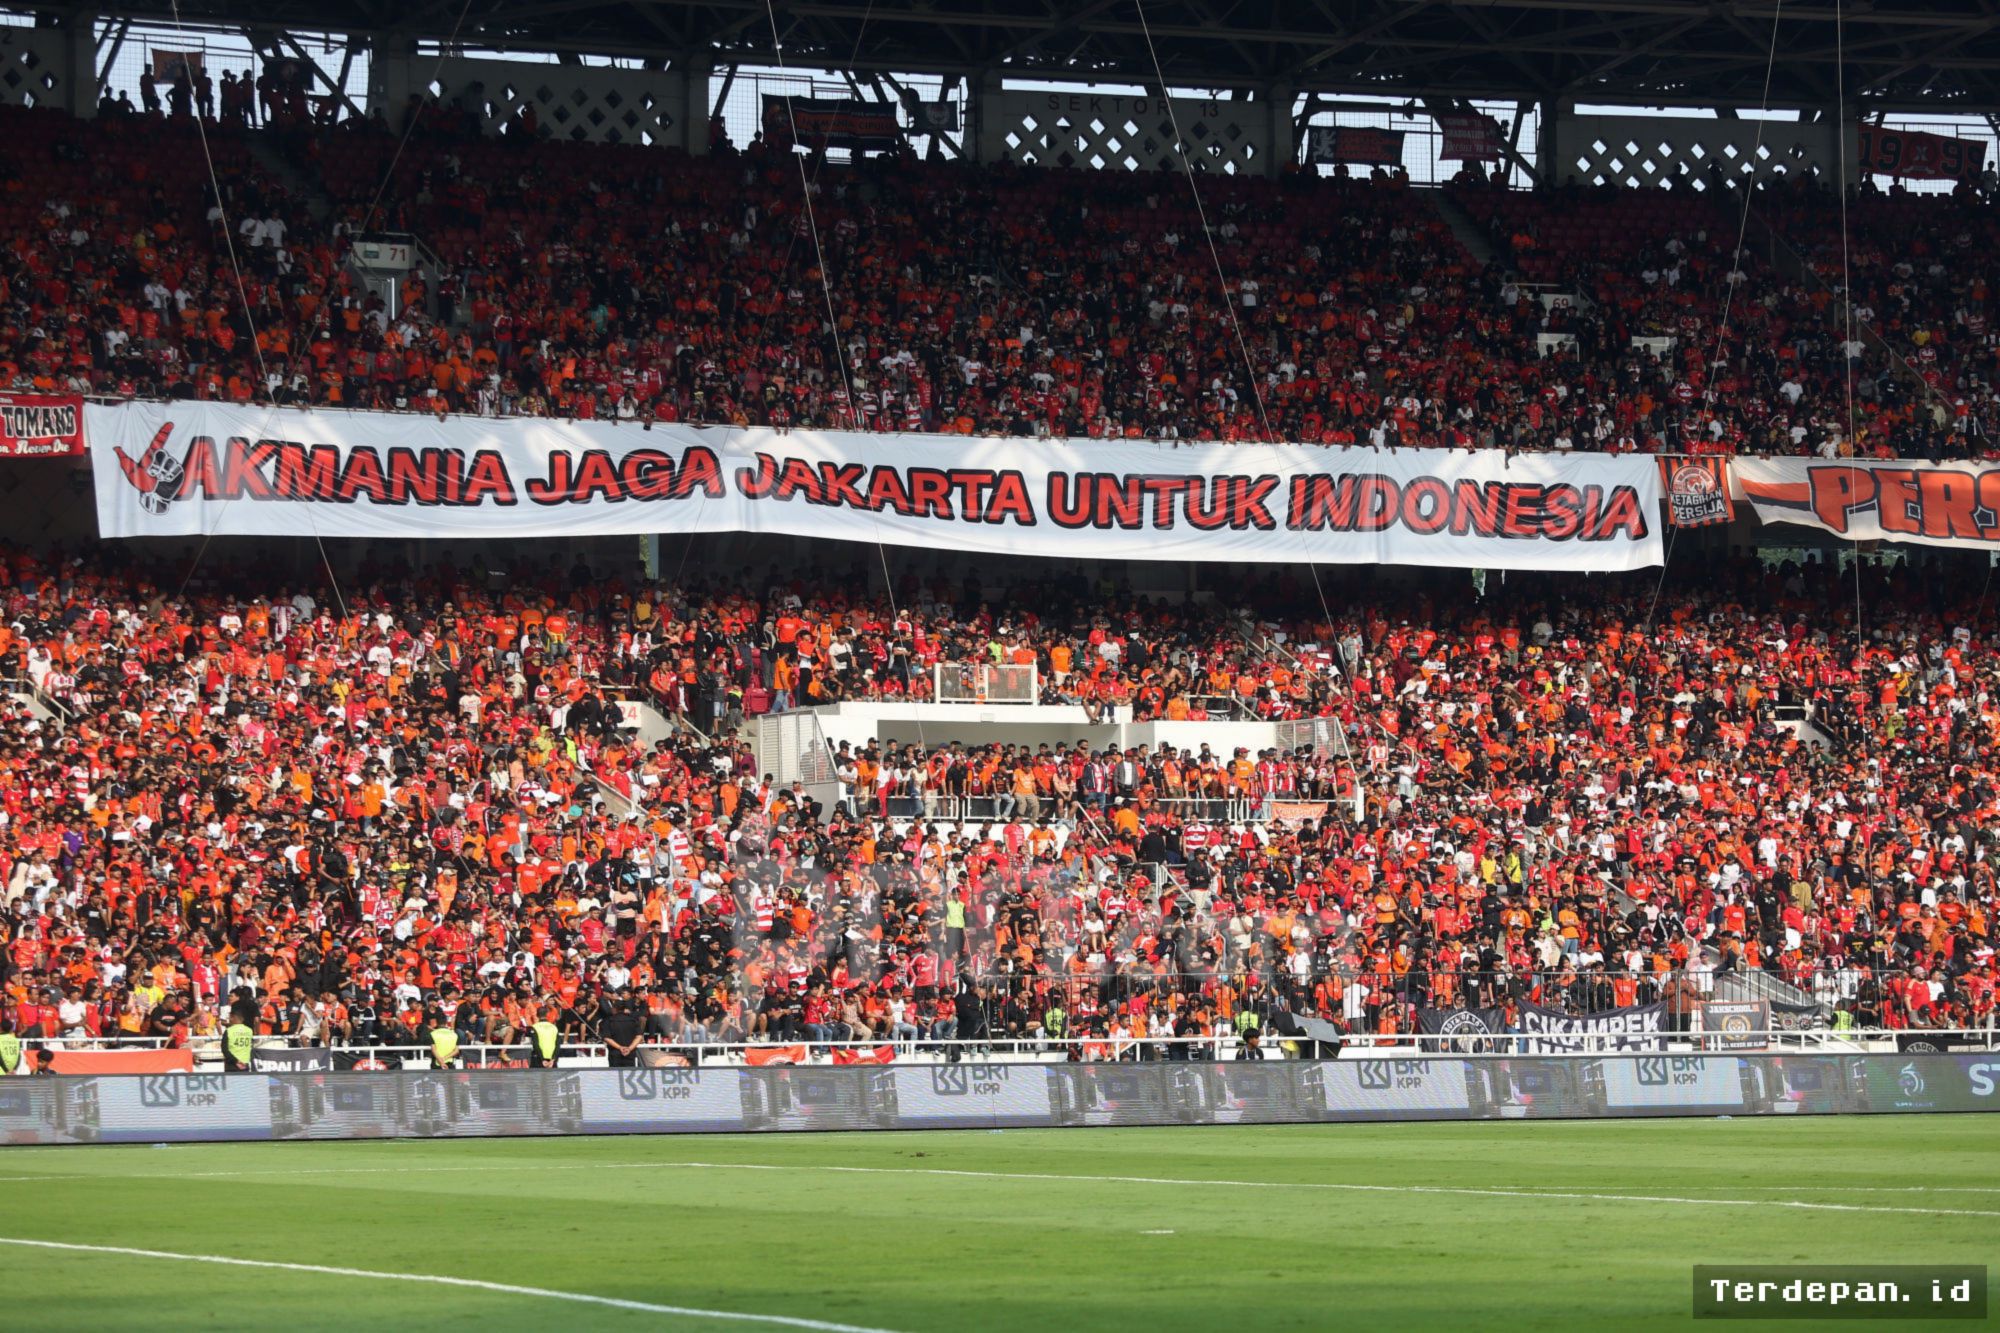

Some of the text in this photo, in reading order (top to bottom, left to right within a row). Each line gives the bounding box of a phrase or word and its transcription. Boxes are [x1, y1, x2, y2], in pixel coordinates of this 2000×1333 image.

[1047, 94, 1219, 118] SEKTOR 13
[390, 247, 406, 262] 71
[523, 445, 727, 506] JAGA
[735, 451, 1037, 527] JAKARTA
[1046, 472, 1283, 531] UNTUK
[1287, 473, 1649, 542] INDONESIA
[1673, 498, 1725, 520] PERSIJA
[1524, 1010, 1662, 1046] CIKAMPEK
[233, 1037, 250, 1048] 450
[1394, 1060, 1431, 1075] BRI
[1671, 1057, 1706, 1071] BRI
[661, 1069, 700, 1084] BRI
[972, 1066, 1009, 1080] BRI
[1674, 1073, 1698, 1085] KPR
[185, 1075, 227, 1091] BRI
[973, 1083, 1001, 1095] KPR
[1397, 1077, 1422, 1089] KPR
[186, 1093, 216, 1106] KPR
[663, 1087, 690, 1099] KPR
